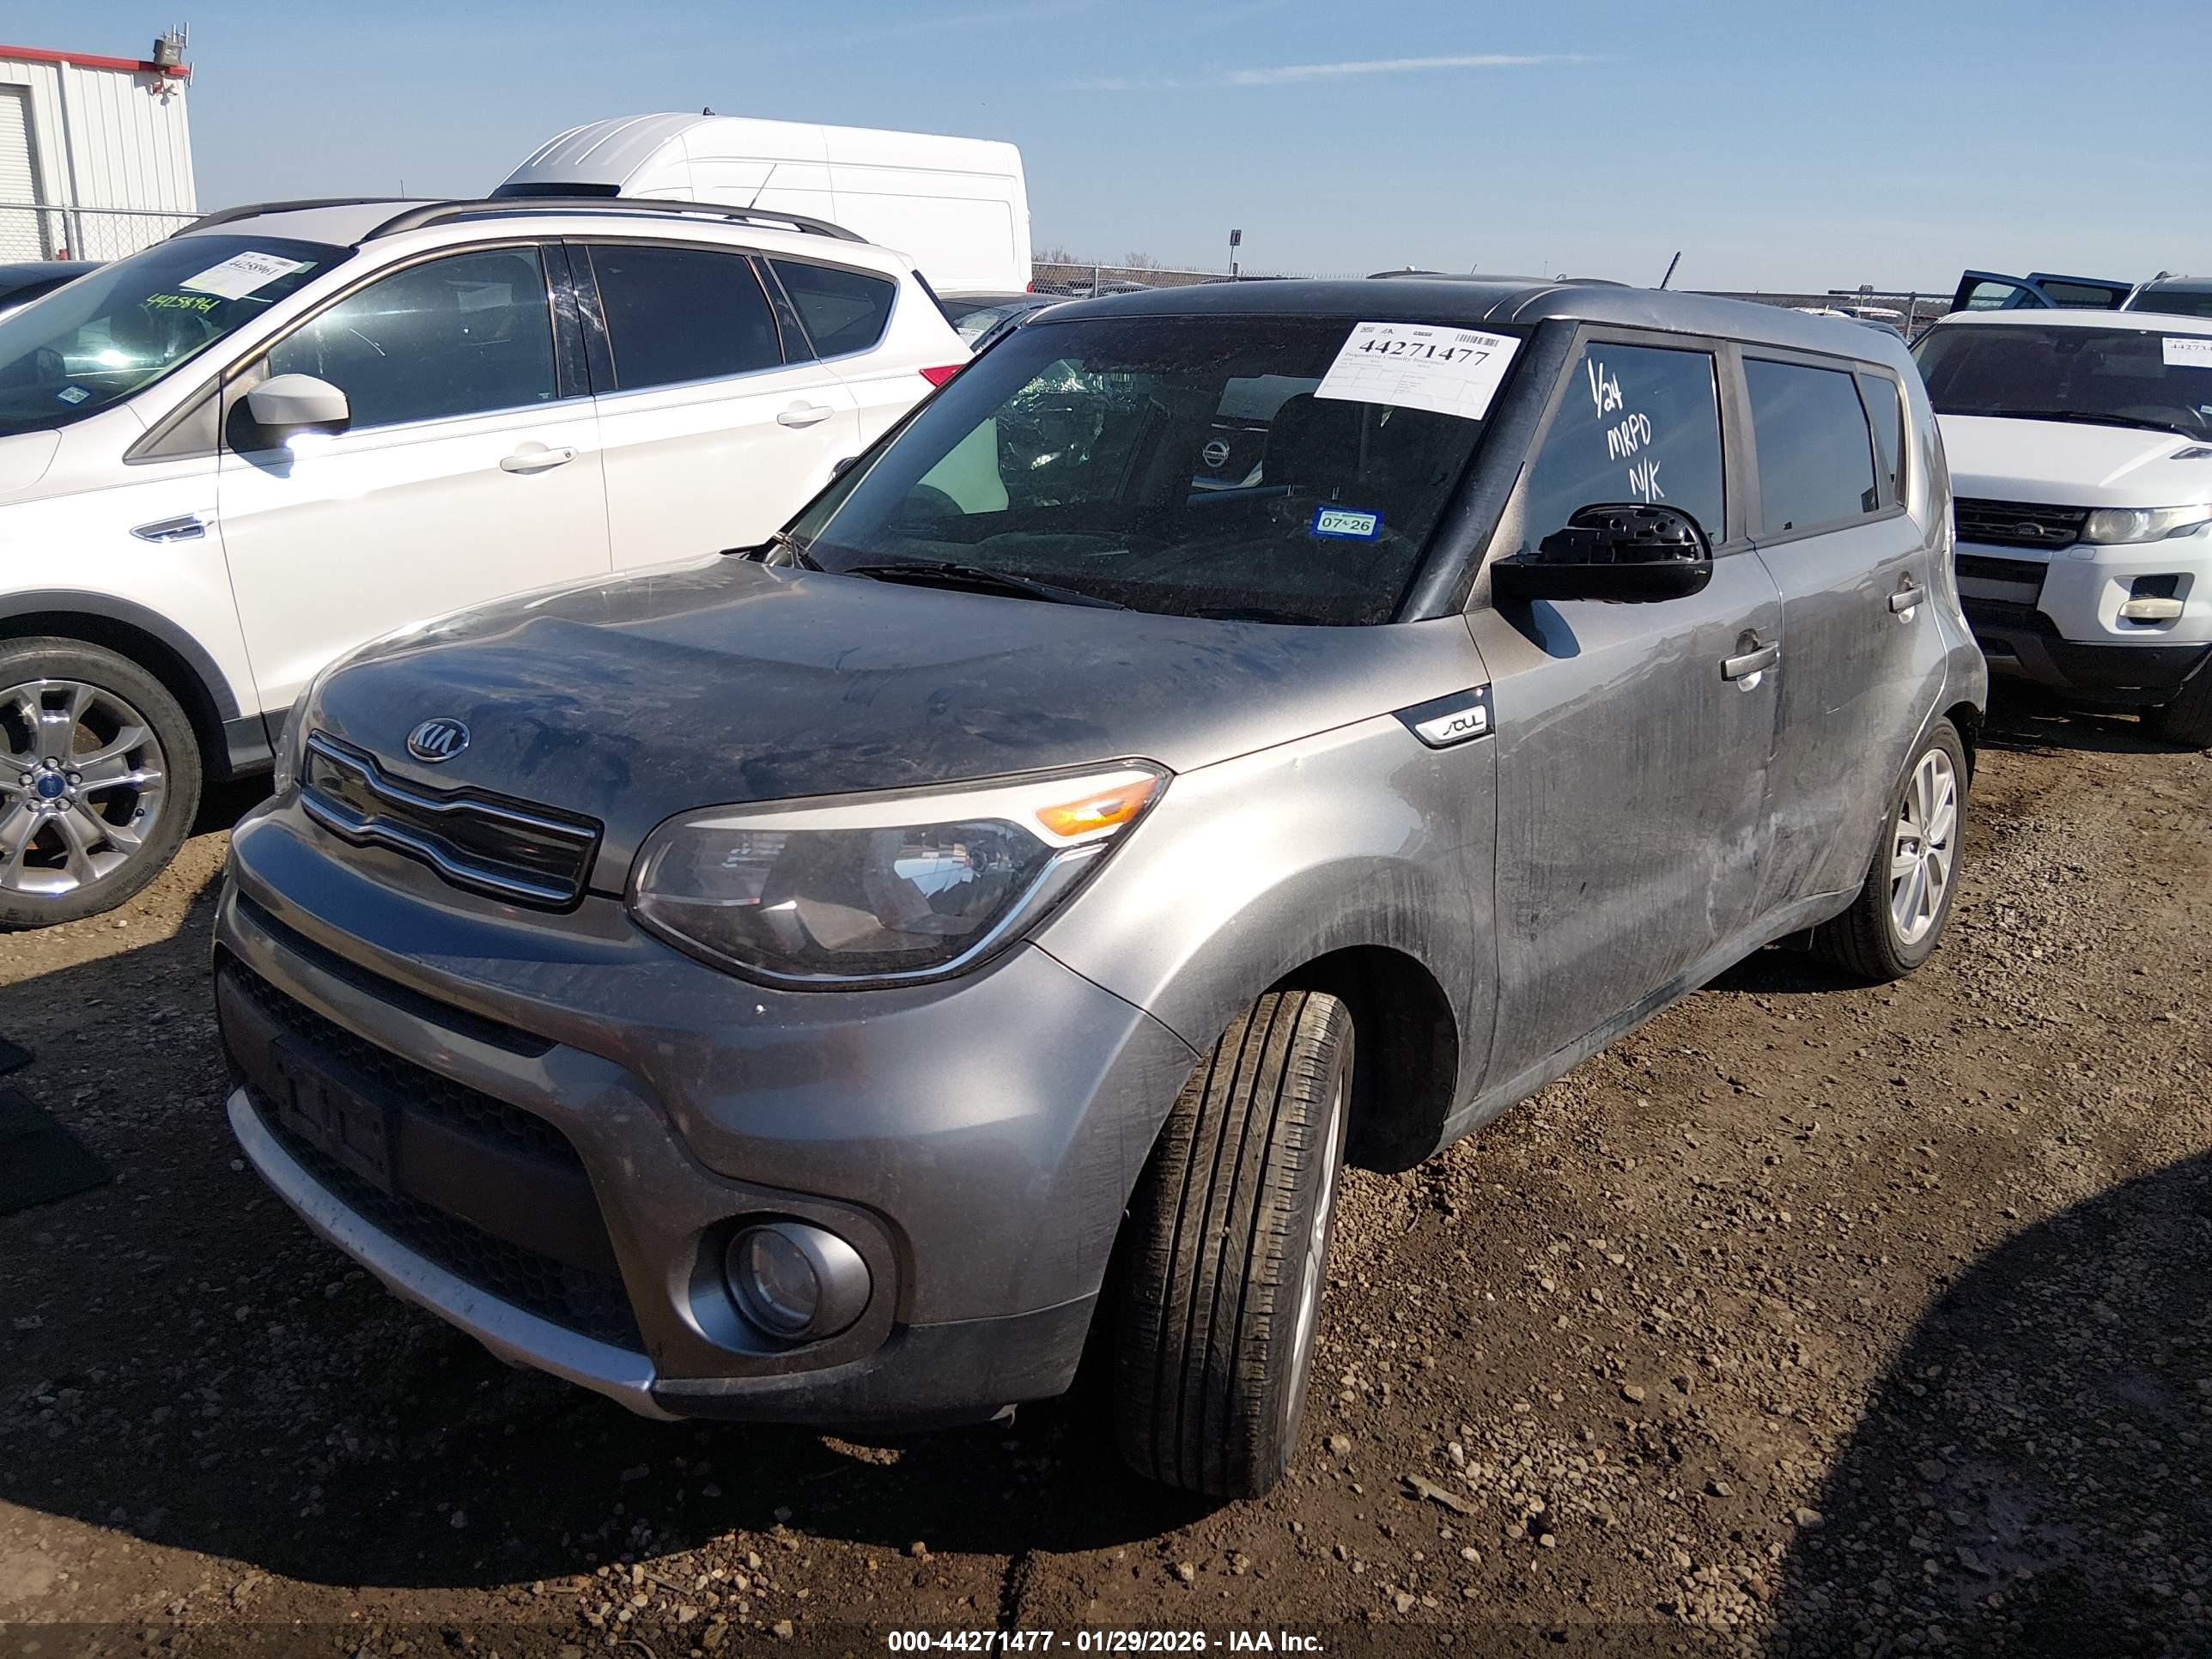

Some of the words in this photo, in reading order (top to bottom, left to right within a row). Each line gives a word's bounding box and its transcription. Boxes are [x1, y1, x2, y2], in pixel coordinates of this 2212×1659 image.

[1358, 339, 1491, 367] 44271477
[1629, 457, 1665, 504] N/K
[1350, 520, 1371, 532] 26
[411, 722, 456, 754] KIA
